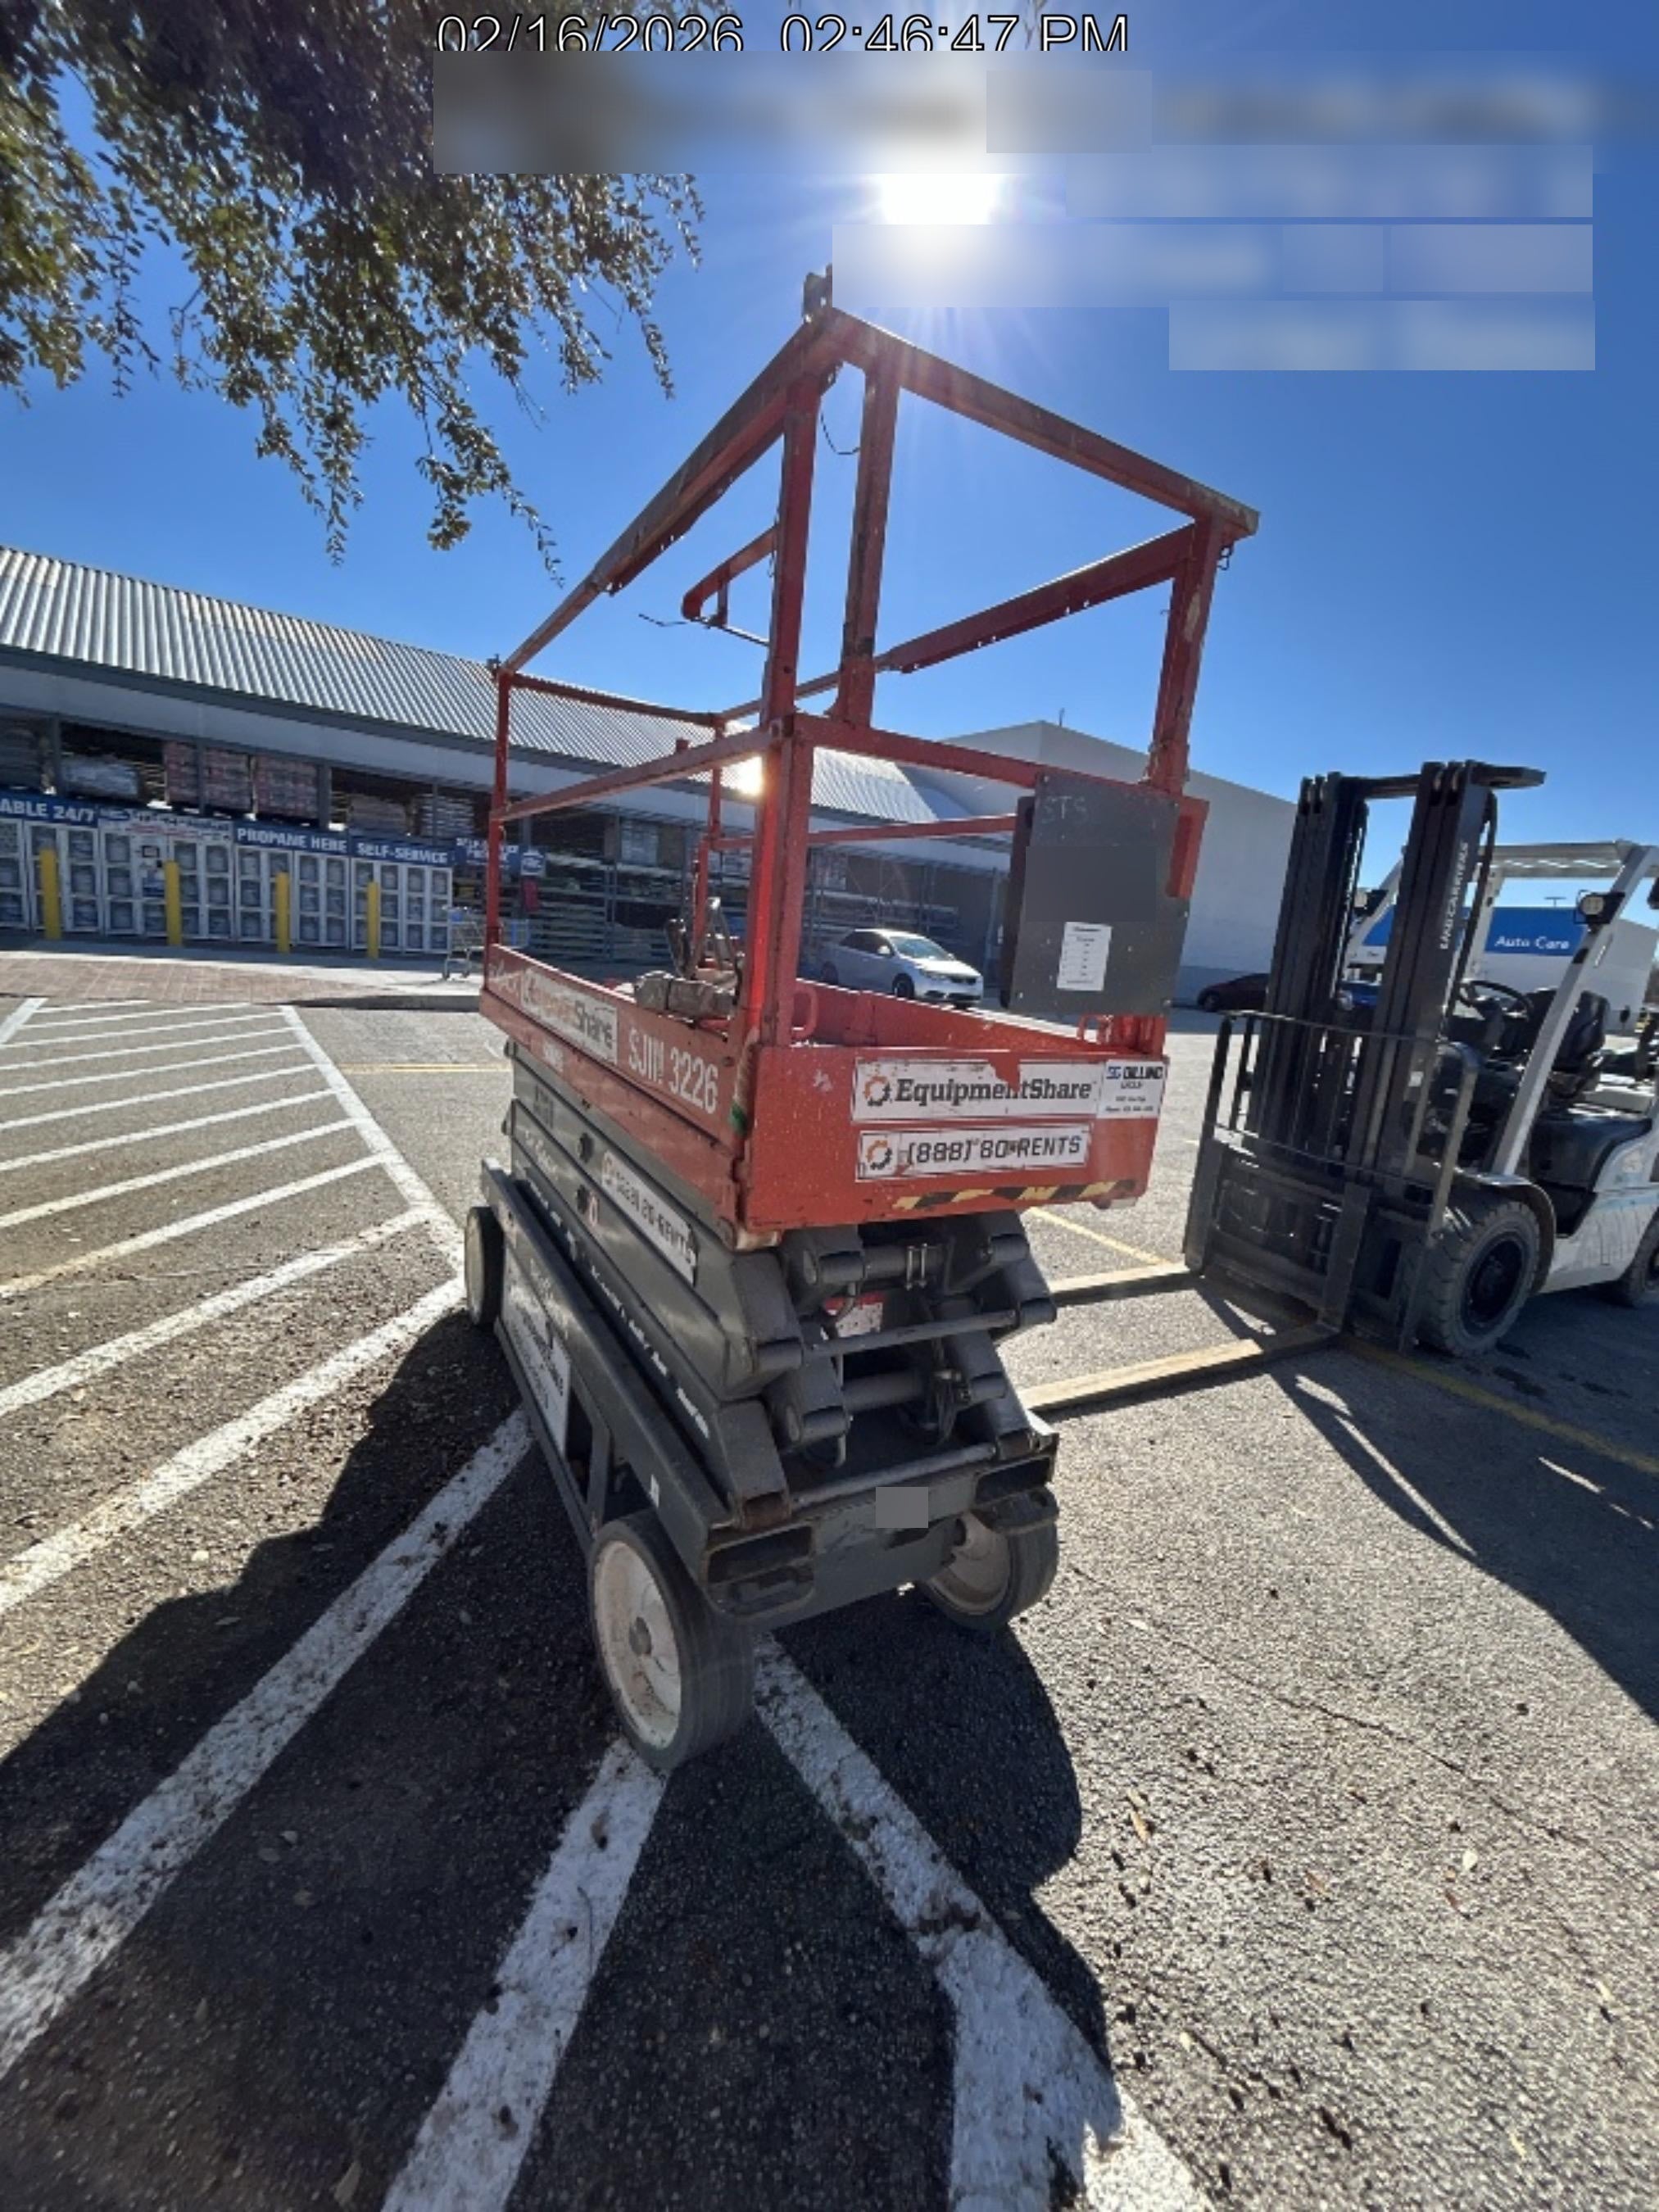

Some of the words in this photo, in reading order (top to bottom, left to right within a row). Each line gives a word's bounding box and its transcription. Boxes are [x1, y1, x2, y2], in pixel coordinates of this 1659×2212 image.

[52, 805, 94, 823] 24/7
[237, 827, 308, 849] PROPANE
[311, 836, 348, 854] HERE
[1494, 935, 1530, 948] Auto
[1534, 935, 1571, 950] Care
[669, 1045, 719, 1115] 3226
